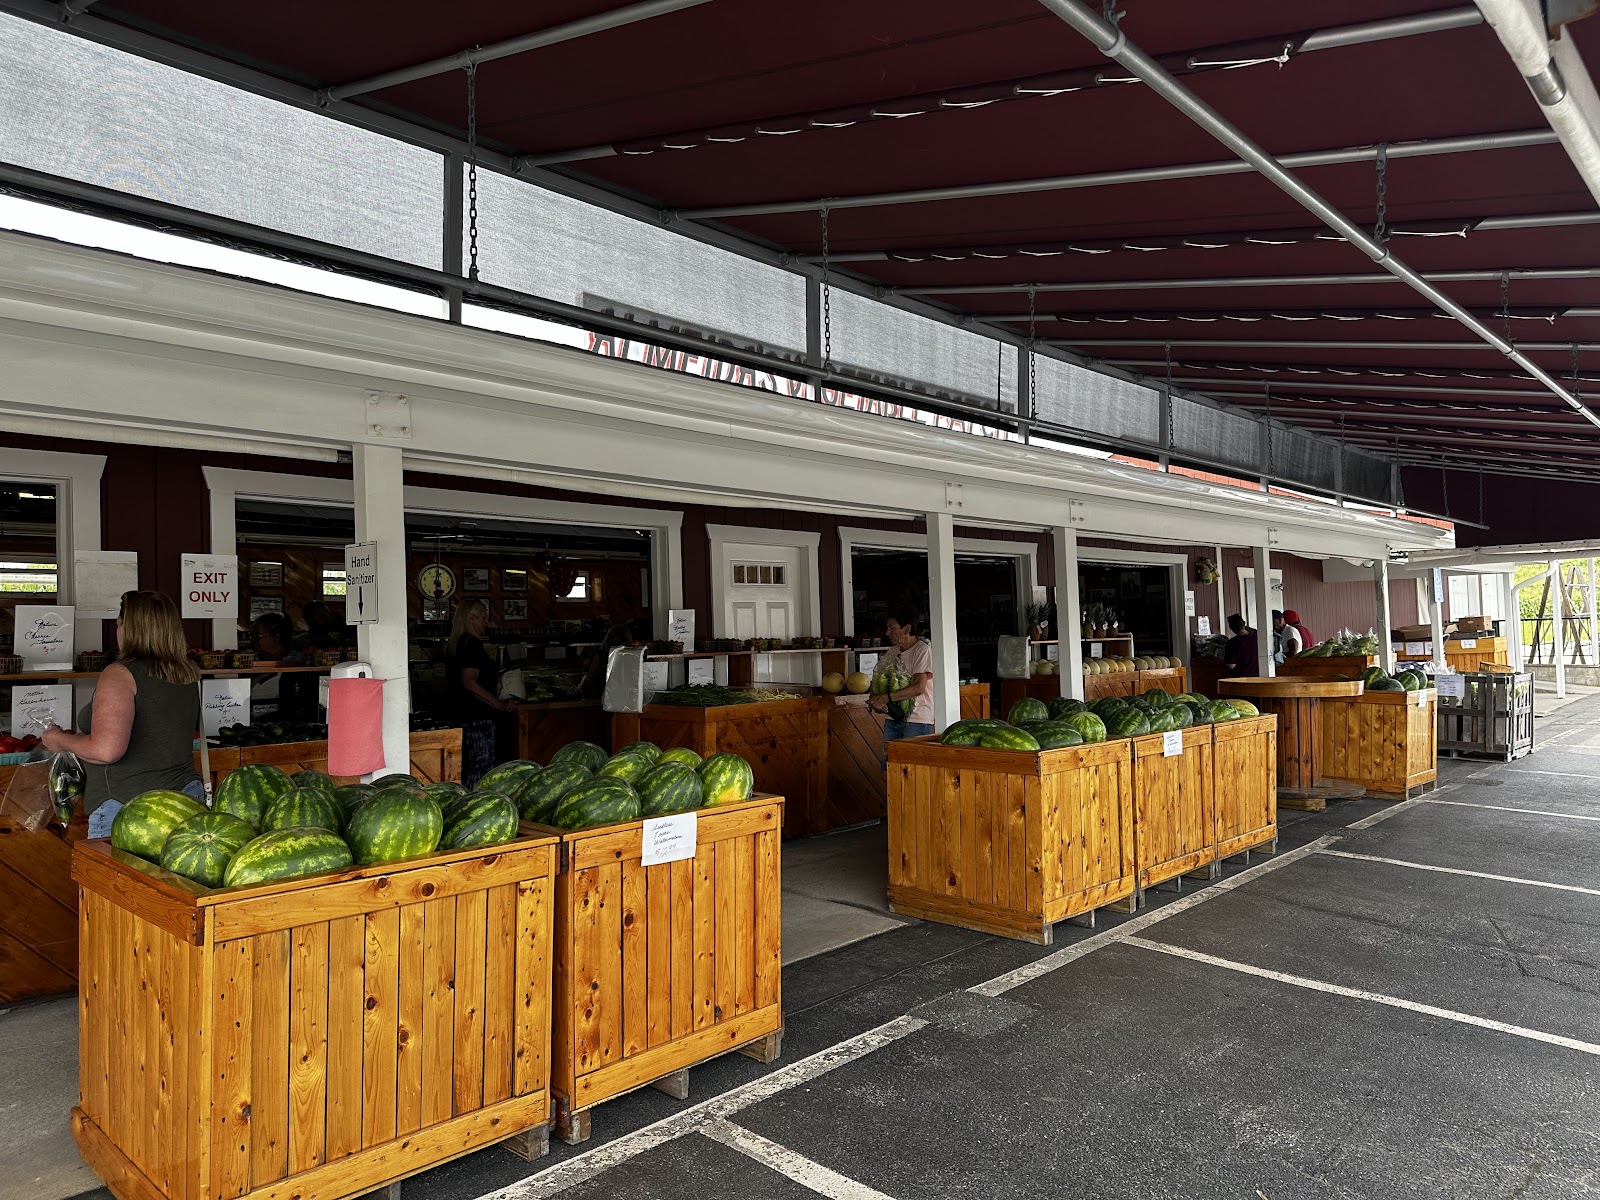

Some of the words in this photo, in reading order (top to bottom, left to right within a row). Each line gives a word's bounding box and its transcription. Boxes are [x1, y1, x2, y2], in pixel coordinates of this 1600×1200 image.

[351, 555, 370, 568] Hand
[193, 572, 228, 584] EXIT
[347, 573, 375, 586] Sanitizer
[189, 590, 231, 603] ONLY
